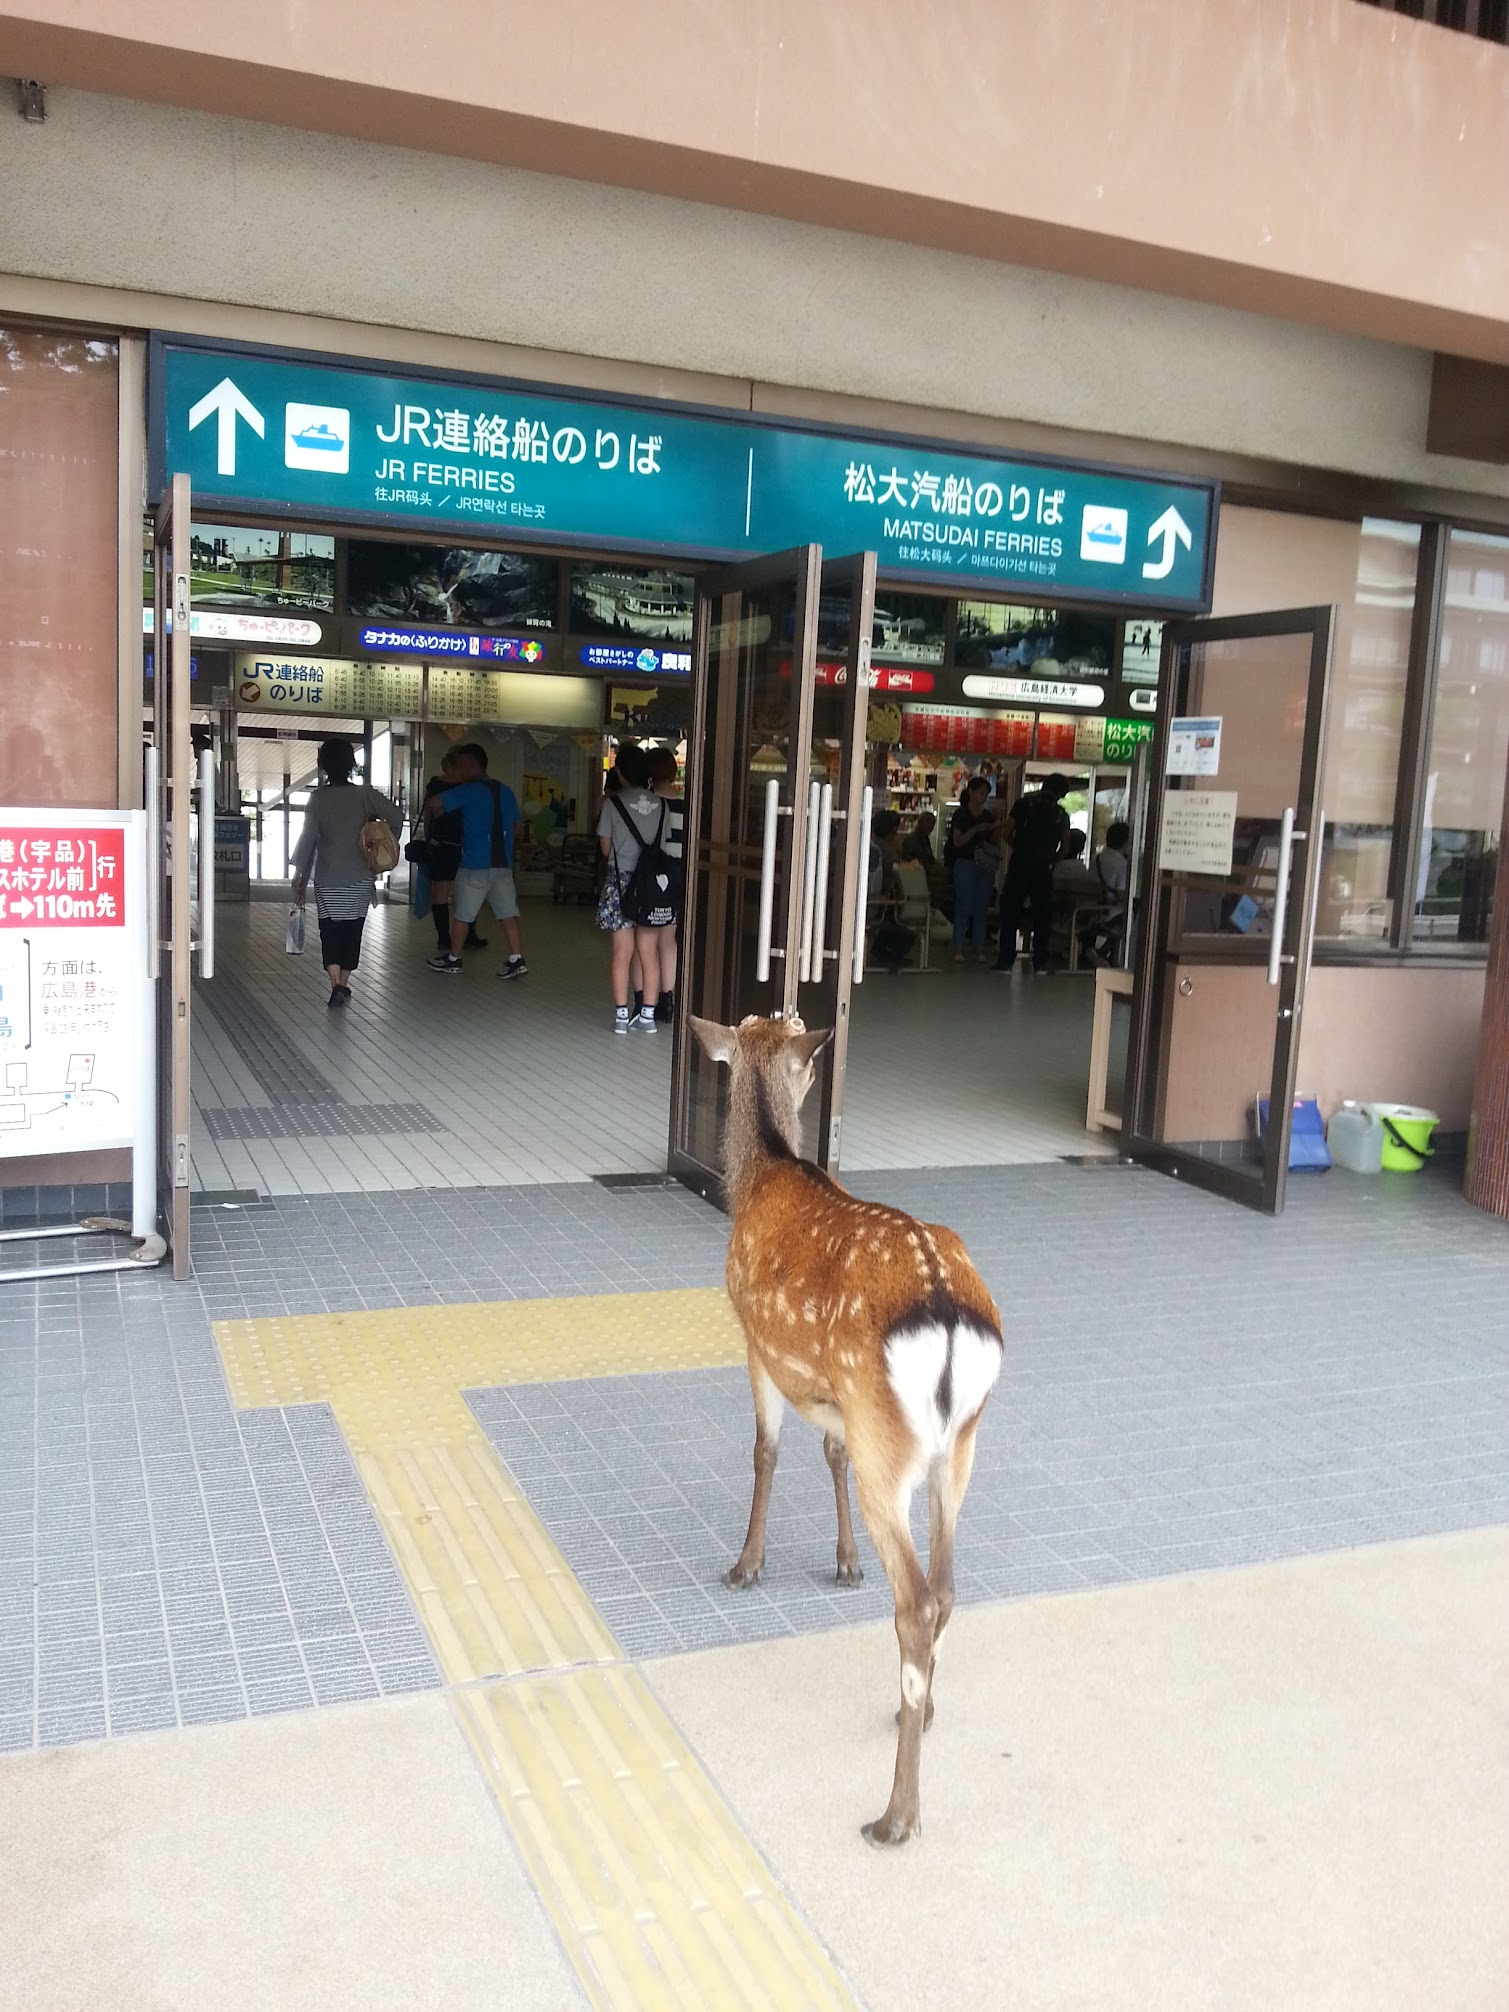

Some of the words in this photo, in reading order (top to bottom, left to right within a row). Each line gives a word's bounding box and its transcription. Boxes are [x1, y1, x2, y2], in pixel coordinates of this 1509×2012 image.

[375, 403, 663, 475] JR連絡船のりば
[375, 458, 406, 482] JR
[414, 462, 516, 494] FERRIES
[843, 460, 1065, 526] 松大汽船のりば
[511, 502, 547, 520] 타는곳
[883, 517, 979, 548] MATSUDAI
[984, 531, 1063, 558] FERRIES
[238, 619, 311, 636] ちゅーピーパーク
[243, 662, 325, 683] JR連絡船
[270, 684, 323, 704] のりば
[1107, 722, 1155, 743] 松大汽
[1106, 743, 1137, 760] のり
[97, 855, 116, 879] 行
